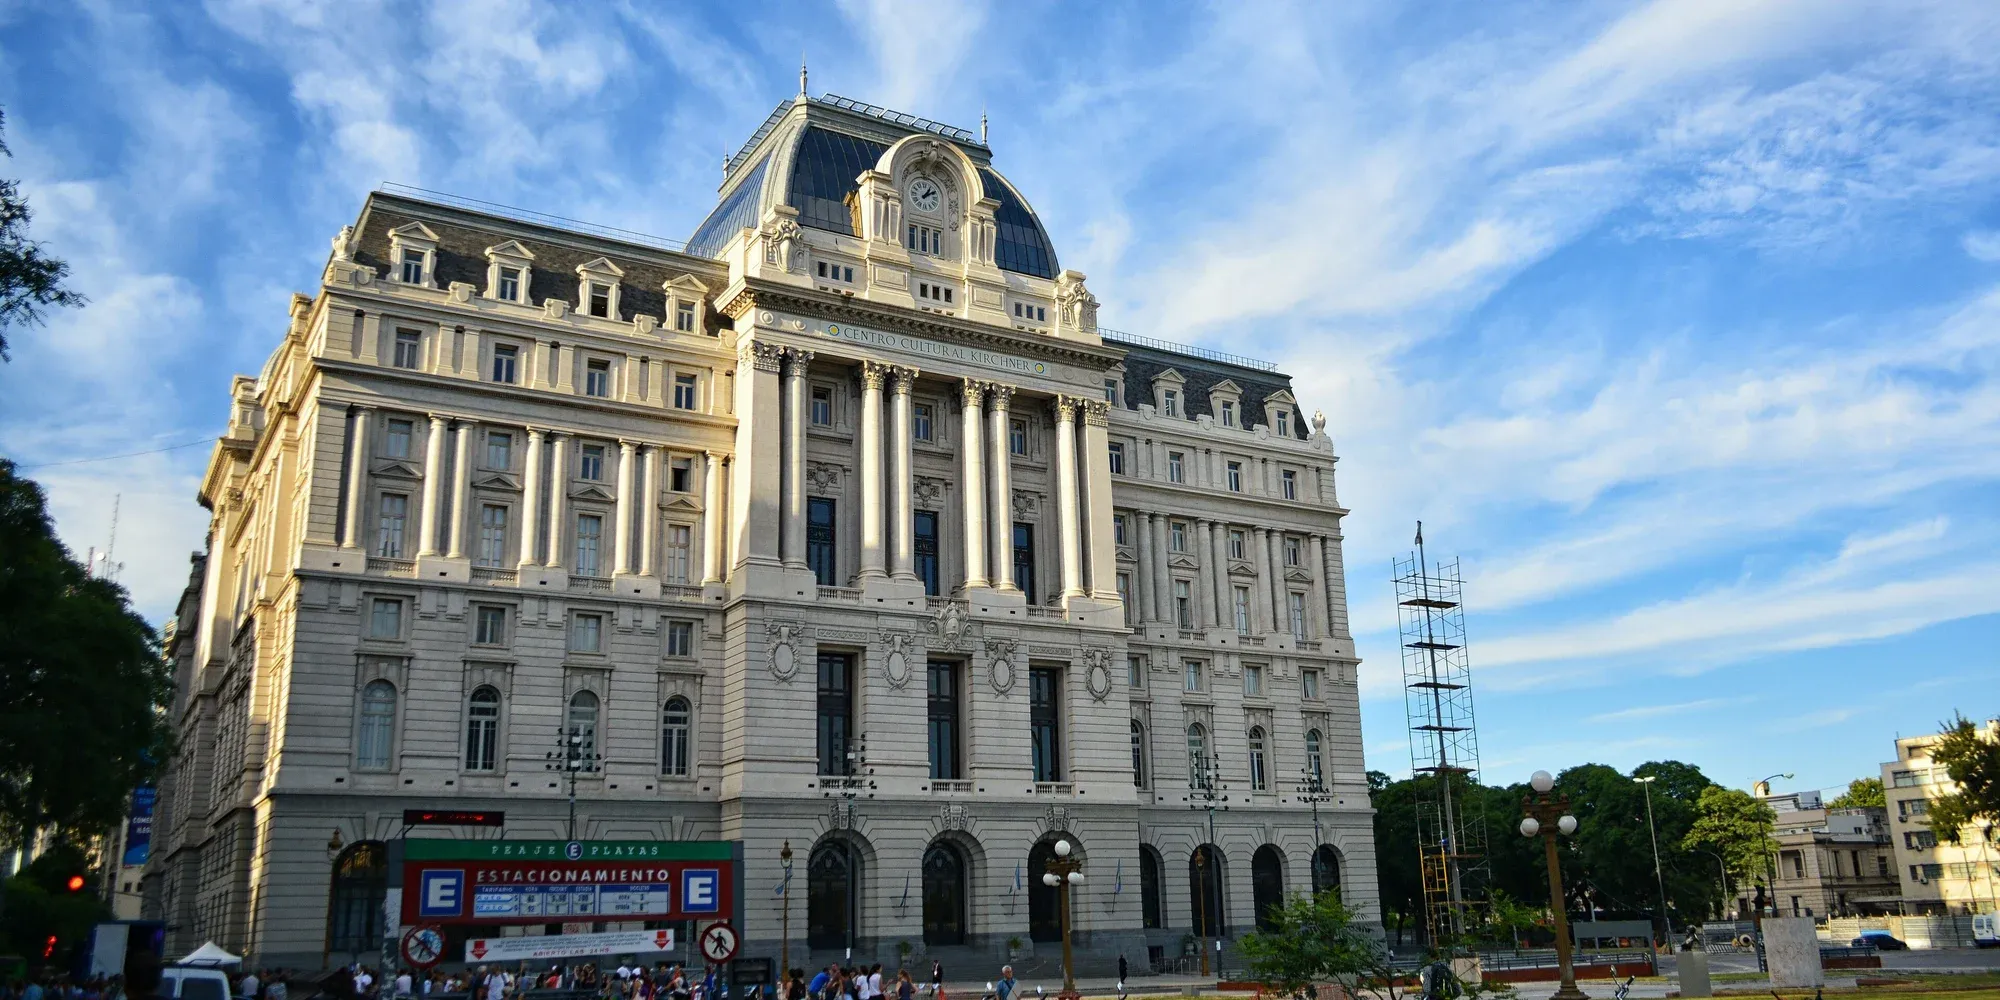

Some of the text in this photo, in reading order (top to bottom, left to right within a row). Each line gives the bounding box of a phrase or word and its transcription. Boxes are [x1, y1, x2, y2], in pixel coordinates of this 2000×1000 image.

[843, 326, 1030, 372] CENTRO CULTURAL KIRCHNER
[491, 845, 557, 856] PEAJE
[570, 845, 578, 857] E
[591, 845, 660, 856] PLAYAS
[476, 868, 669, 884] ESTACIONAMIENTO
[427, 878, 457, 909] E
[688, 876, 713, 905] E
[532, 950, 567, 958] ABIERTO
